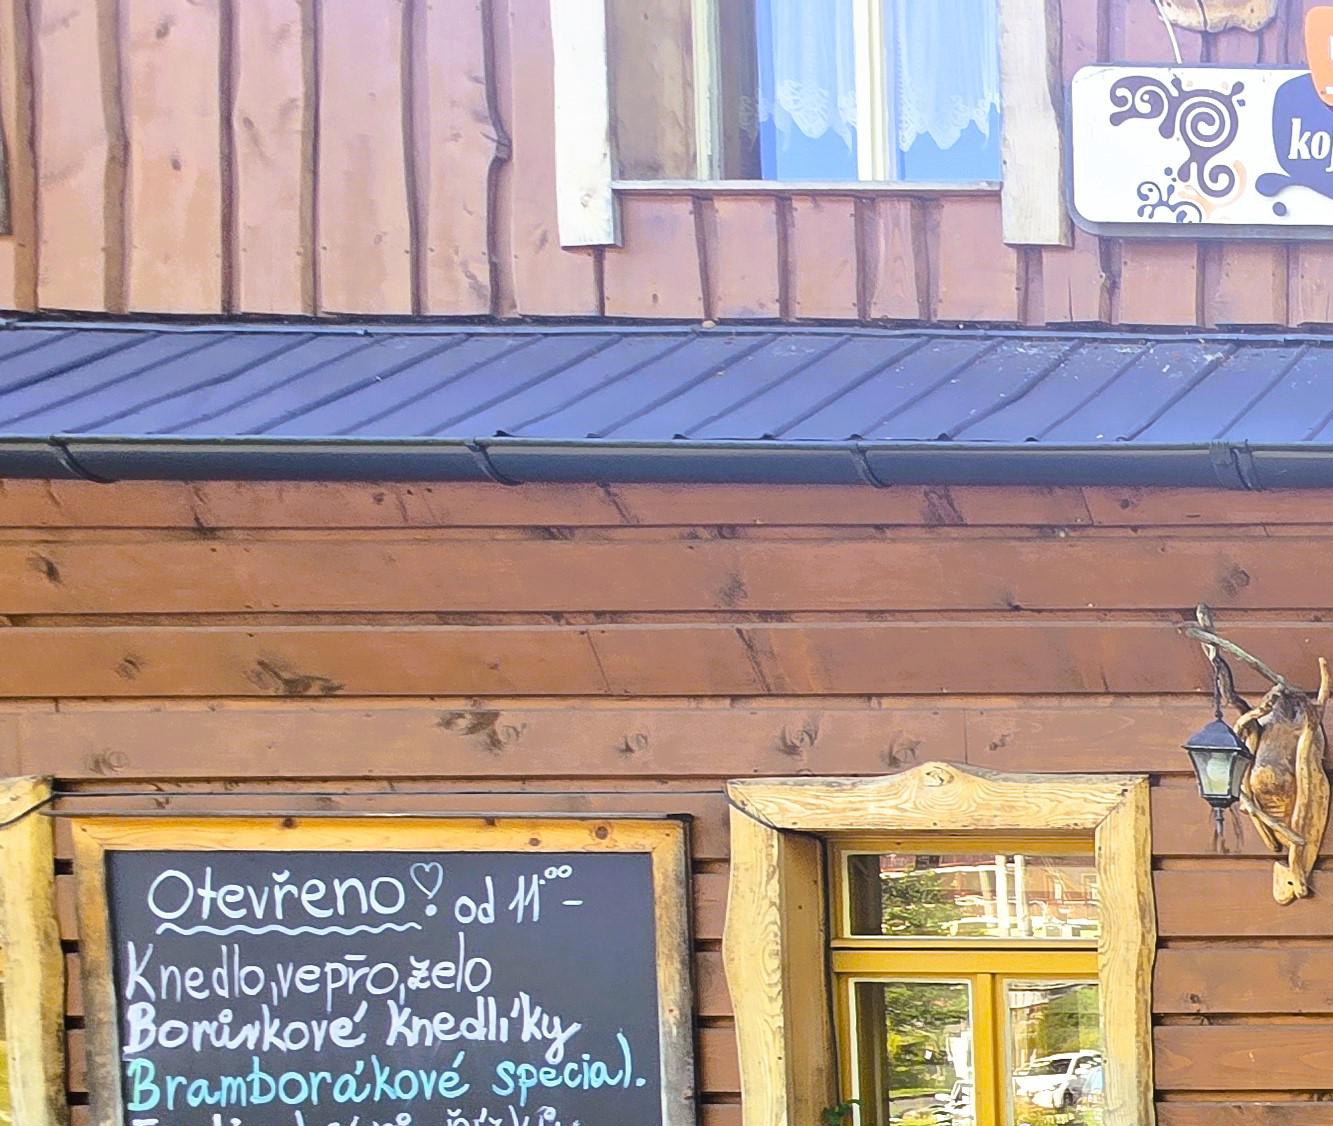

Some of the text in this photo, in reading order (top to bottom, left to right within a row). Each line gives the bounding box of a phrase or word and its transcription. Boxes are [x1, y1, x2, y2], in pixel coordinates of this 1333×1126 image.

[454, 875, 495, 924] od
[123, 1000, 368, 1054] Borůvkové
[127, 1050, 470, 1112] Bramborákové
